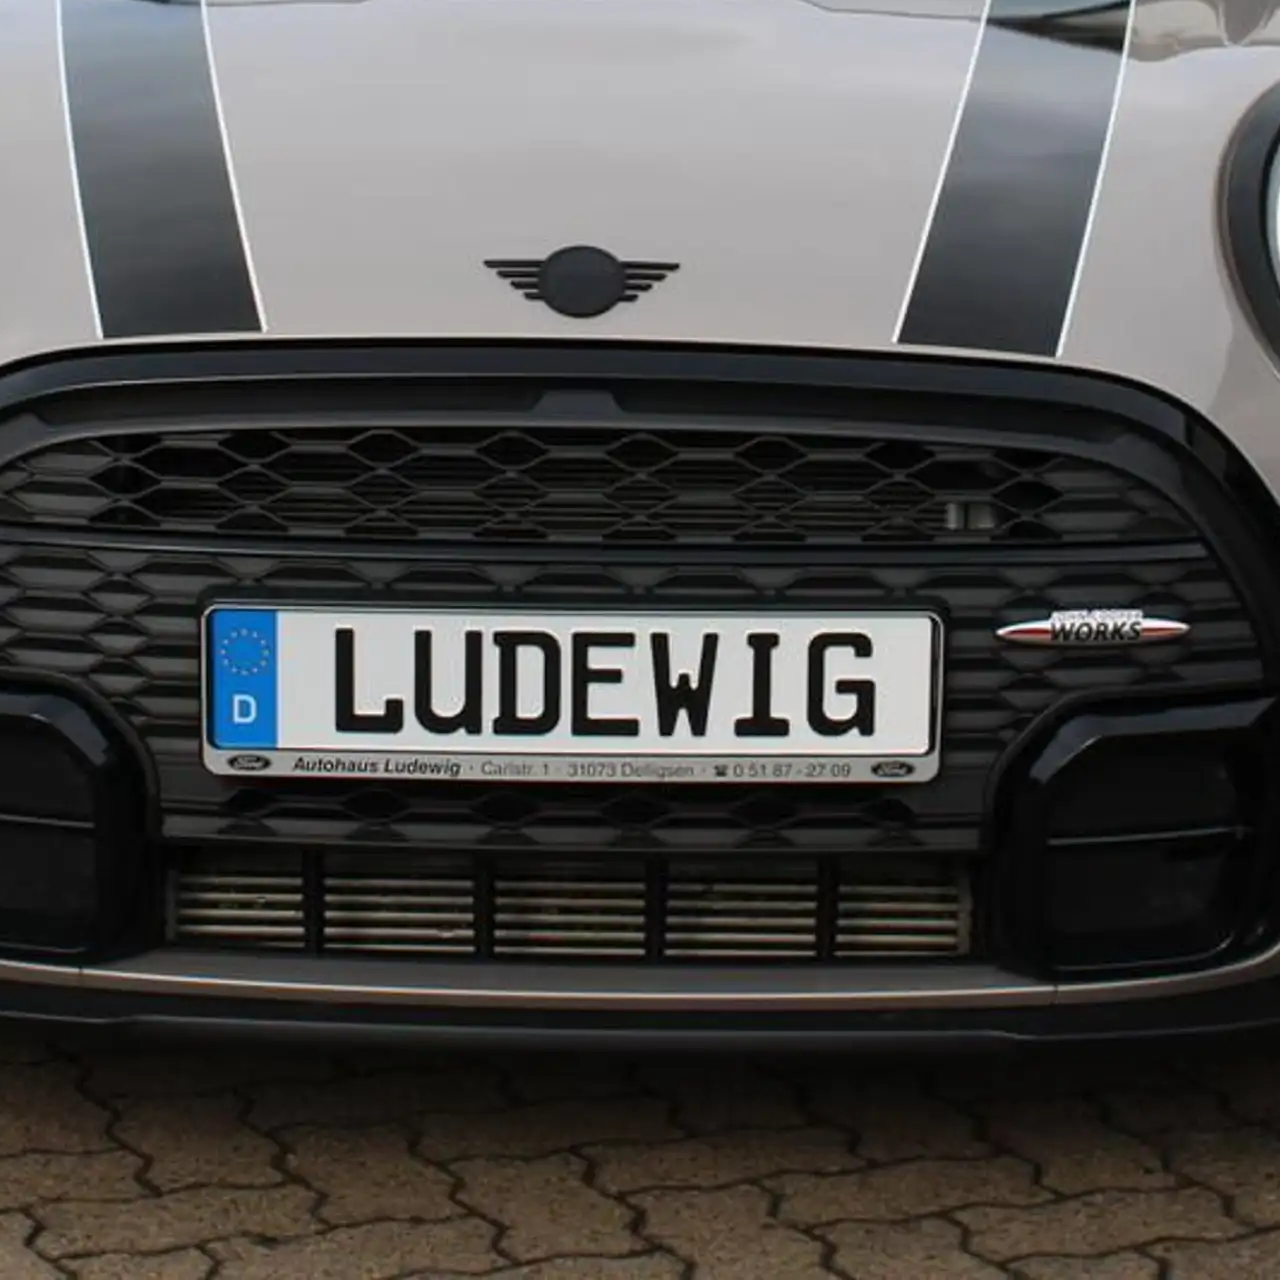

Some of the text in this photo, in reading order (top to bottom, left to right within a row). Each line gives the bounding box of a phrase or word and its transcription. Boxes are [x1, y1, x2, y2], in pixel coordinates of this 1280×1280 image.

[1050, 620, 1142, 641] WORKS
[335, 628, 875, 737] LUDEWIG
[232, 694, 258, 724] D
[293, 755, 379, 773] Autohaus
[383, 757, 462, 779] Ludewig
[566, 762, 617, 778] 31073
